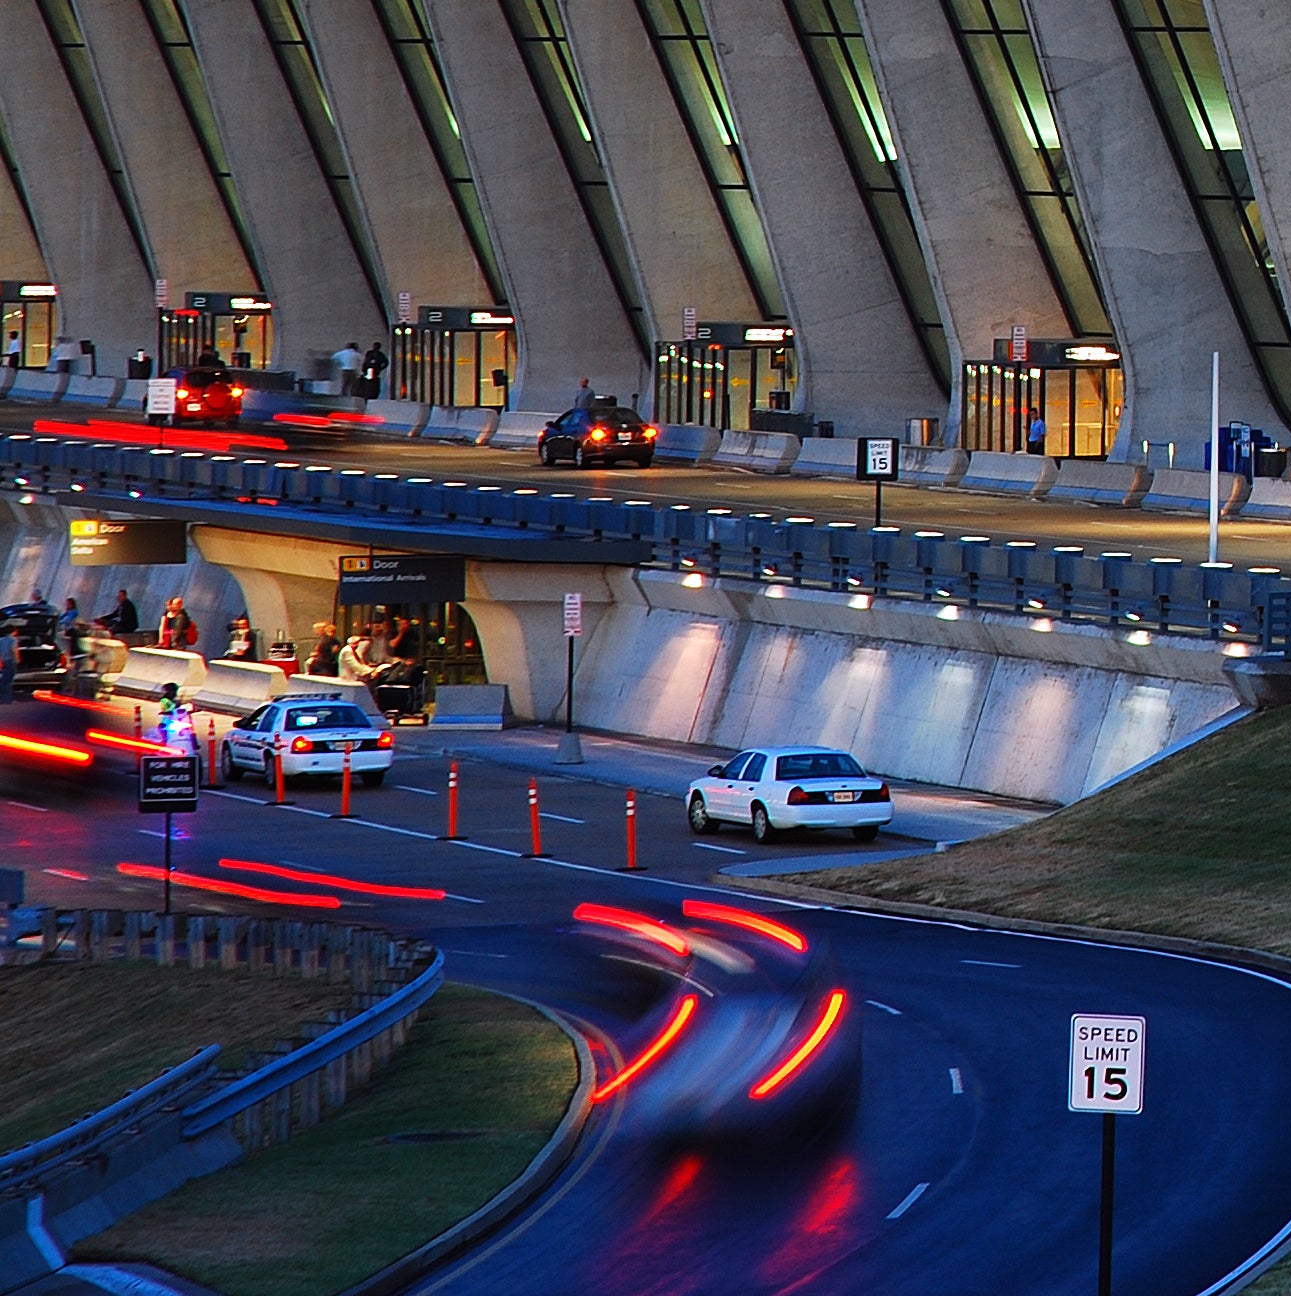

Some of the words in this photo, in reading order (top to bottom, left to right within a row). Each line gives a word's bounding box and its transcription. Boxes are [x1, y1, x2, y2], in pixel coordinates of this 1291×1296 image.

[194, 297, 206, 307] 2
[429, 311, 443, 322] 2
[698, 328, 711, 339] 2
[872, 457, 888, 470] 15
[373, 560, 399, 569] Door
[342, 575, 394, 583] International
[396, 573, 427, 581] Arrivals
[150, 774, 190, 782] VEHICLES
[145, 786, 194, 794] PROHIBITED
[1079, 1027, 1138, 1042] SPEED
[1084, 1046, 1130, 1061] LIMIT
[1084, 1066, 1128, 1101] 15
